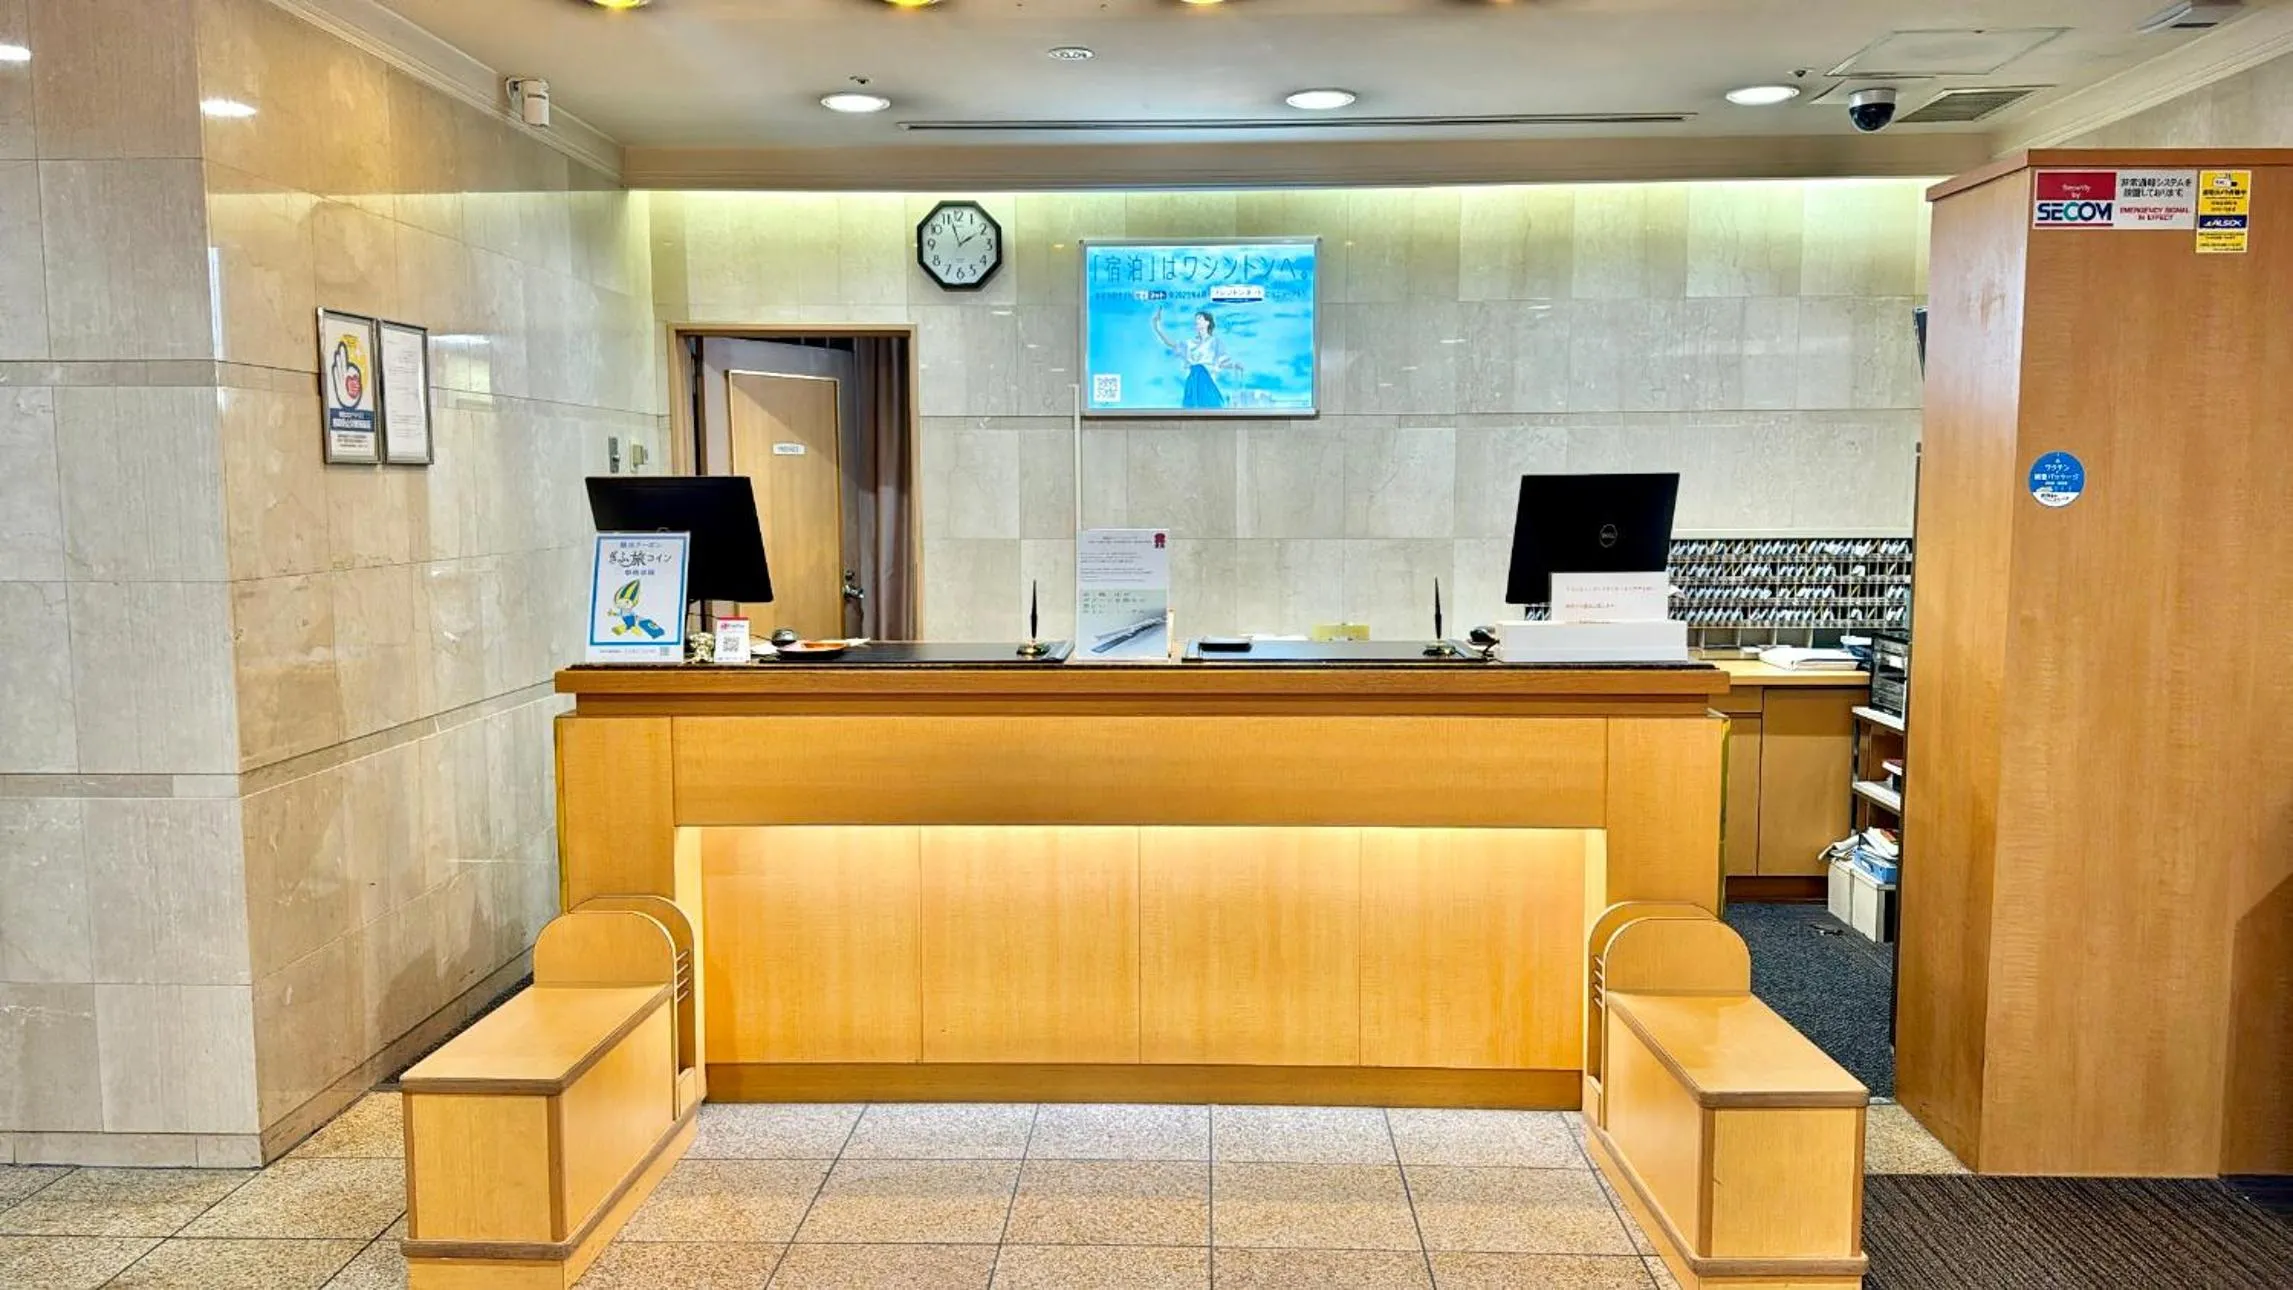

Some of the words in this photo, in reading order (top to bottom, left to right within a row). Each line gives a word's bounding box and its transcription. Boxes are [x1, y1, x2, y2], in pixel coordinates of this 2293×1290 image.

[954, 210, 963, 222] 12
[2037, 202, 2112, 221] SECOM
[942, 213, 950, 225] 11
[931, 222, 942, 235] 10
[980, 222, 987, 235] 2
[927, 238, 936, 250] 9
[985, 238, 993, 251] 3
[933, 254, 941, 266] 8
[980, 254, 987, 266] 4
[945, 264, 952, 276] 7
[956, 267, 965, 280] 6
[970, 264, 976, 276] 5
[1094, 254, 1308, 282] 「宿泊」はワシントンへ。
[609, 550, 672, 567] ぎふ旅コイン
